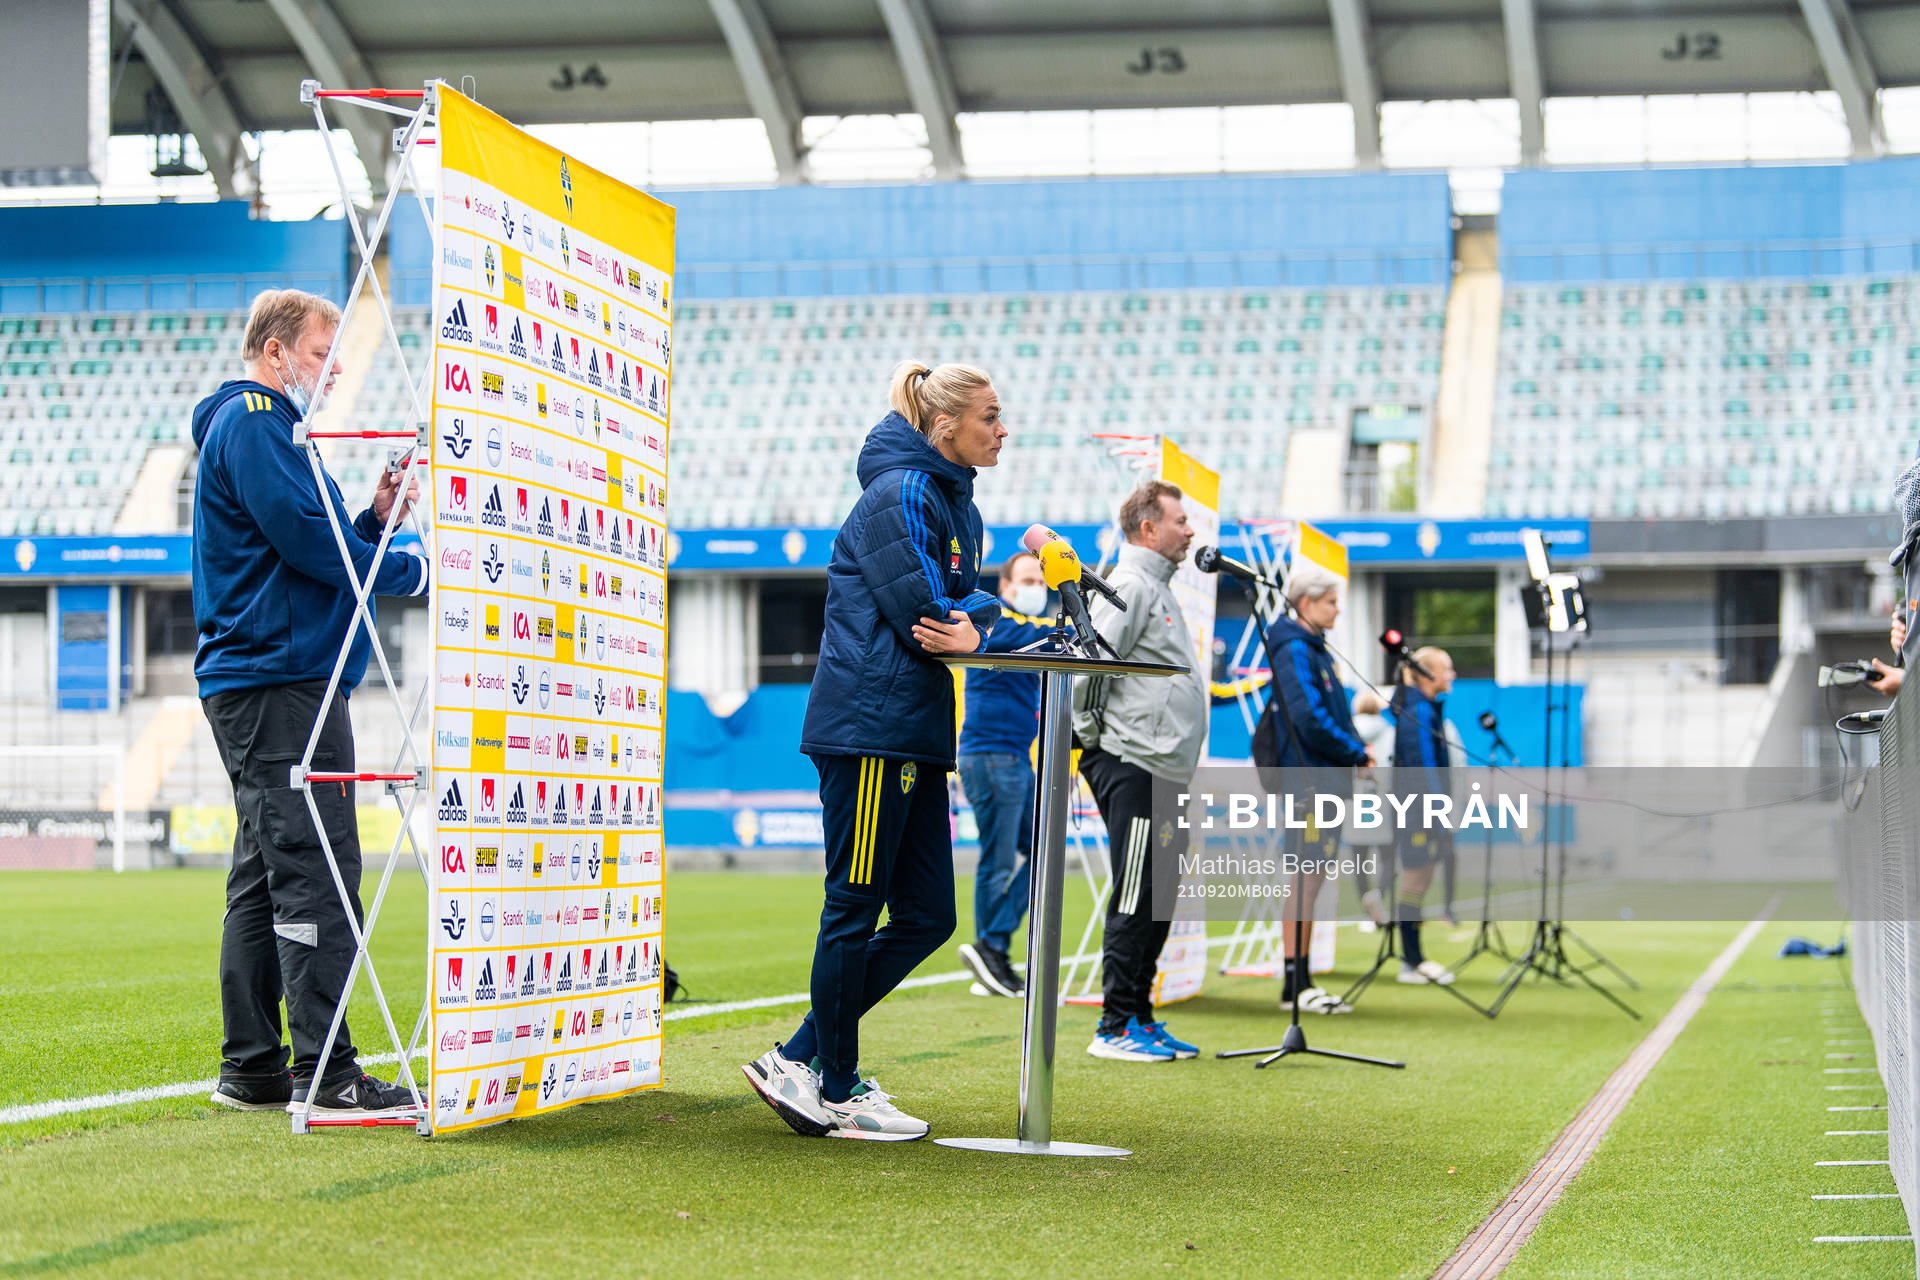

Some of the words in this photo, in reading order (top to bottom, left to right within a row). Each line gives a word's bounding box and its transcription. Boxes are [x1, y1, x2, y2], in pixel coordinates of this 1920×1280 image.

[1661, 32, 1722, 60] J2
[1126, 48, 1186, 75] J3
[549, 63, 609, 91] J4
[443, 248, 472, 270] Folksam
[612, 259, 624, 288] ICA
[546, 279, 560, 310] ICA
[442, 325, 472, 342] adidas
[509, 341, 527, 359] adidas
[446, 363, 472, 394] ICA
[482, 372, 504, 395] SPORT
[454, 418, 464, 438] SJ
[511, 442, 532, 460] Scandic
[440, 512, 462, 521] SVENSKA
[464, 516, 474, 524] SPEL
[482, 511, 506, 527] adidas
[537, 522, 554, 537] adidas
[490, 544, 498, 562] SJ
[596, 570, 606, 598] ICA
[444, 611, 468, 632] Fabege
[514, 612, 530, 640] ICA
[477, 673, 504, 690] Scandic
[518, 666, 524, 684] SJ
[626, 686, 634, 710] ICA
[438, 730, 469, 748] Folksam
[557, 733, 569, 759] ICA
[438, 806, 467, 822] adidas
[474, 816, 491, 824] SVENSKA
[506, 806, 526, 823] adidas
[442, 846, 466, 873] ICA
[476, 848, 498, 867] SPORT
[450, 900, 458, 918] SJ
[503, 911, 523, 926] Scandic
[475, 984, 496, 1000] adidas
[521, 981, 534, 996] adidas
[556, 977, 572, 992] adidas
[440, 996, 460, 1004] SVENSKA
[460, 996, 468, 1004] SPEL
[571, 1010, 586, 1036] ICA
[472, 1030, 493, 1044] BAUHAUS
[484, 1079, 499, 1106] ICA
